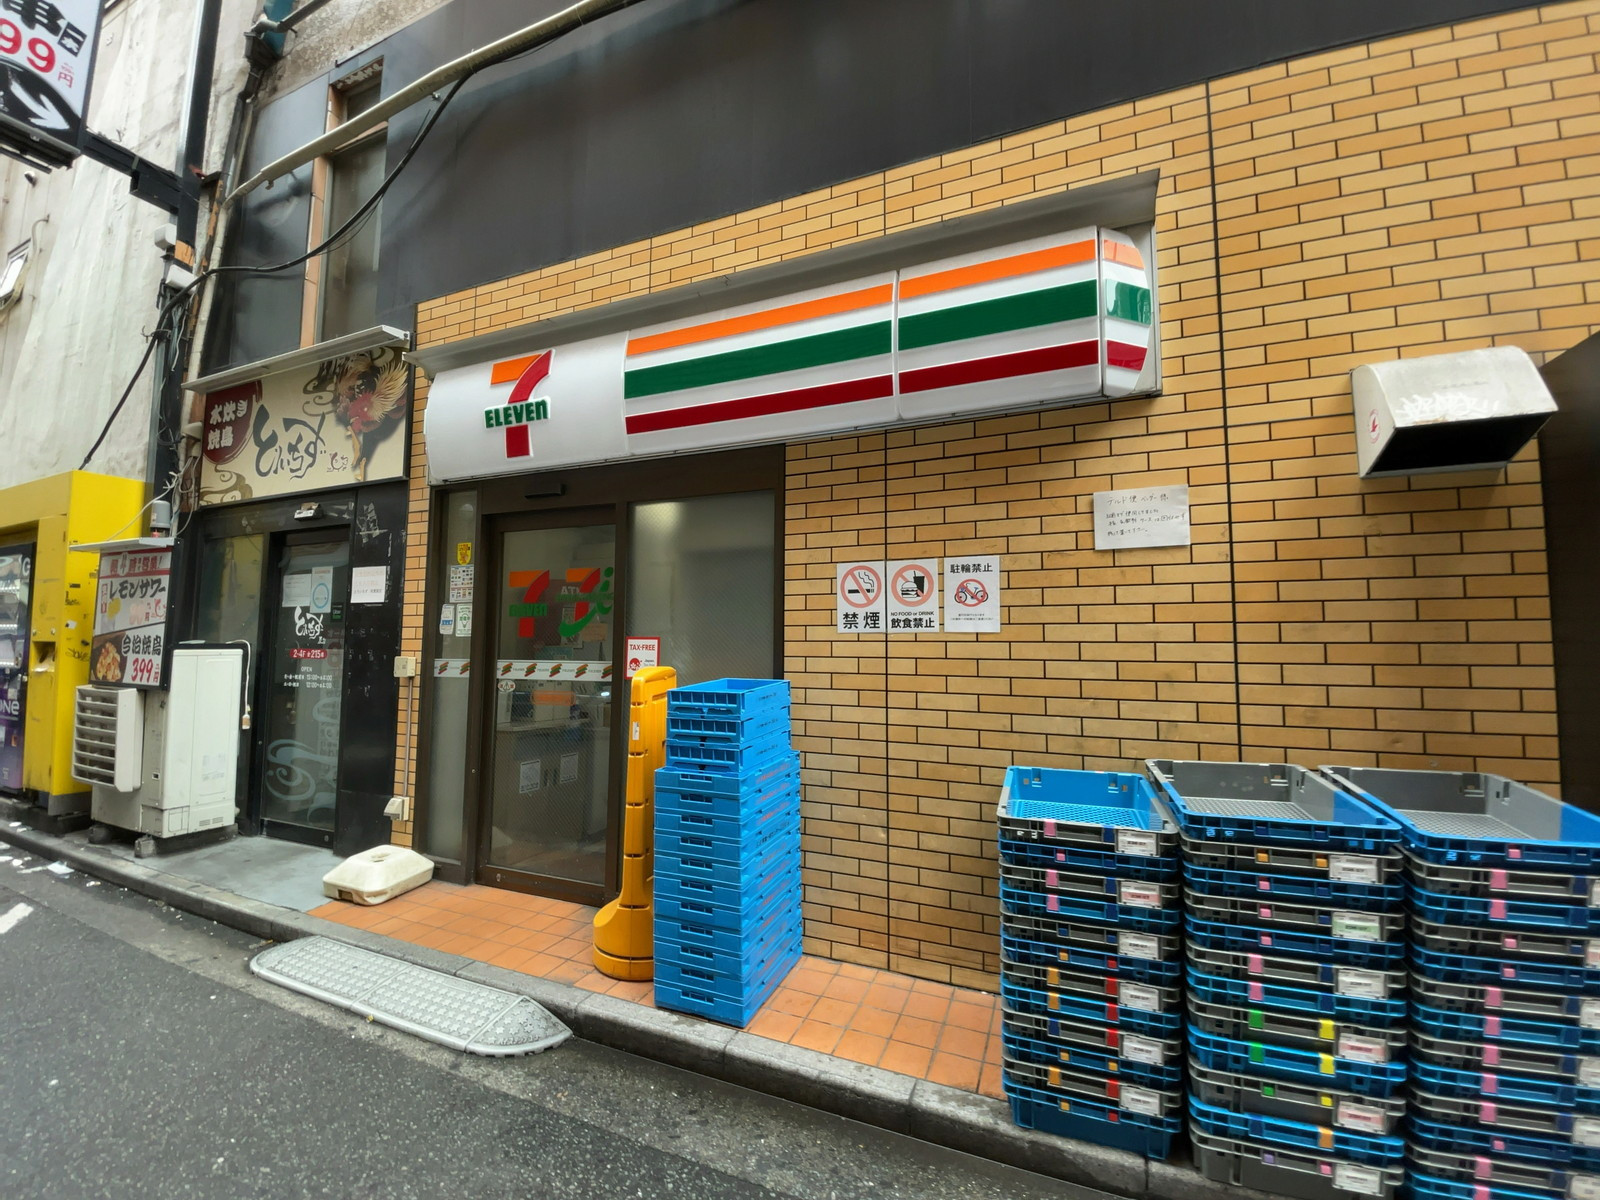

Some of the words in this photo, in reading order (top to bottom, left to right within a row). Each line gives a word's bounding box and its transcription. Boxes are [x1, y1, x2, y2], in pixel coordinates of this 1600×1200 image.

[950, 563, 993, 574] 駐輪禁止
[109, 578, 167, 600] レモンサワー
[842, 611, 880, 630] 禁煙
[890, 617, 935, 629] 飲食禁止
[629, 643, 656, 651] TAX-FREE
